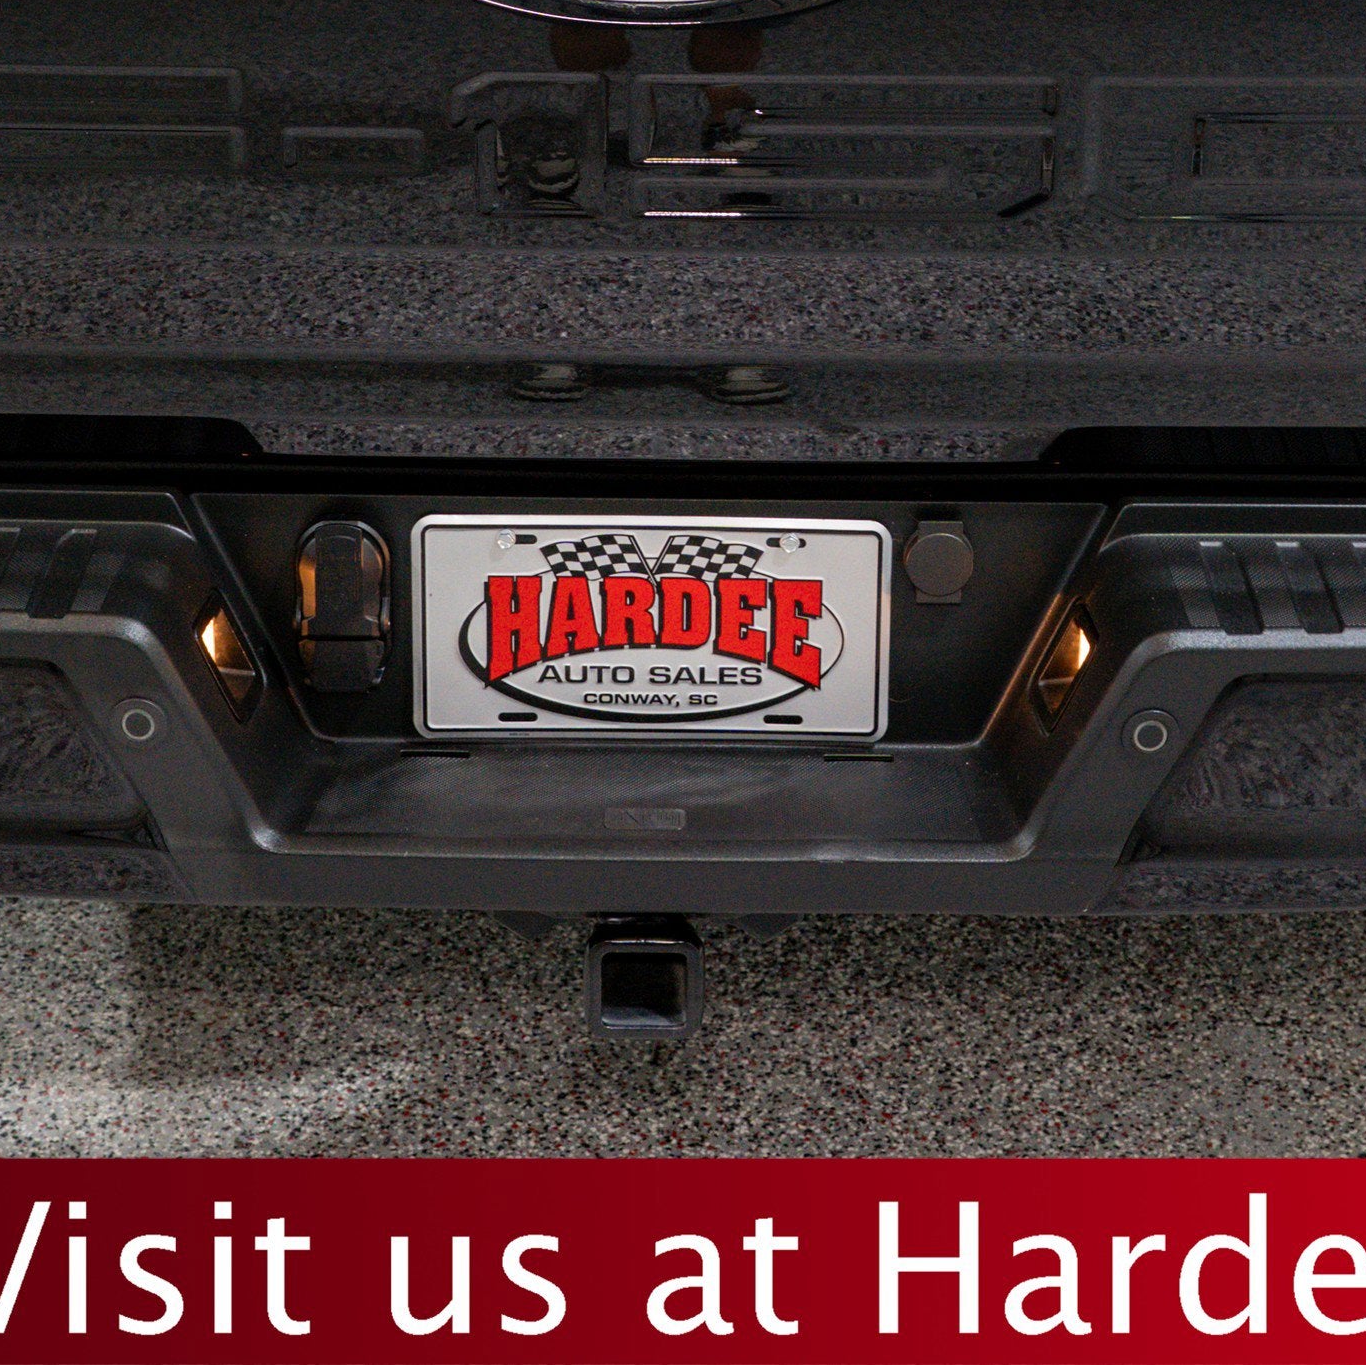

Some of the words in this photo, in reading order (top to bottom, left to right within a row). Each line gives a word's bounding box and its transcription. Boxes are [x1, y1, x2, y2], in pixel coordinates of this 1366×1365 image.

[484, 575, 823, 688] HARDEE
[537, 664, 635, 685] AUTO
[649, 665, 763, 686] SALES
[583, 692, 680, 708] CONWAY,
[688, 692, 718, 706] SC
